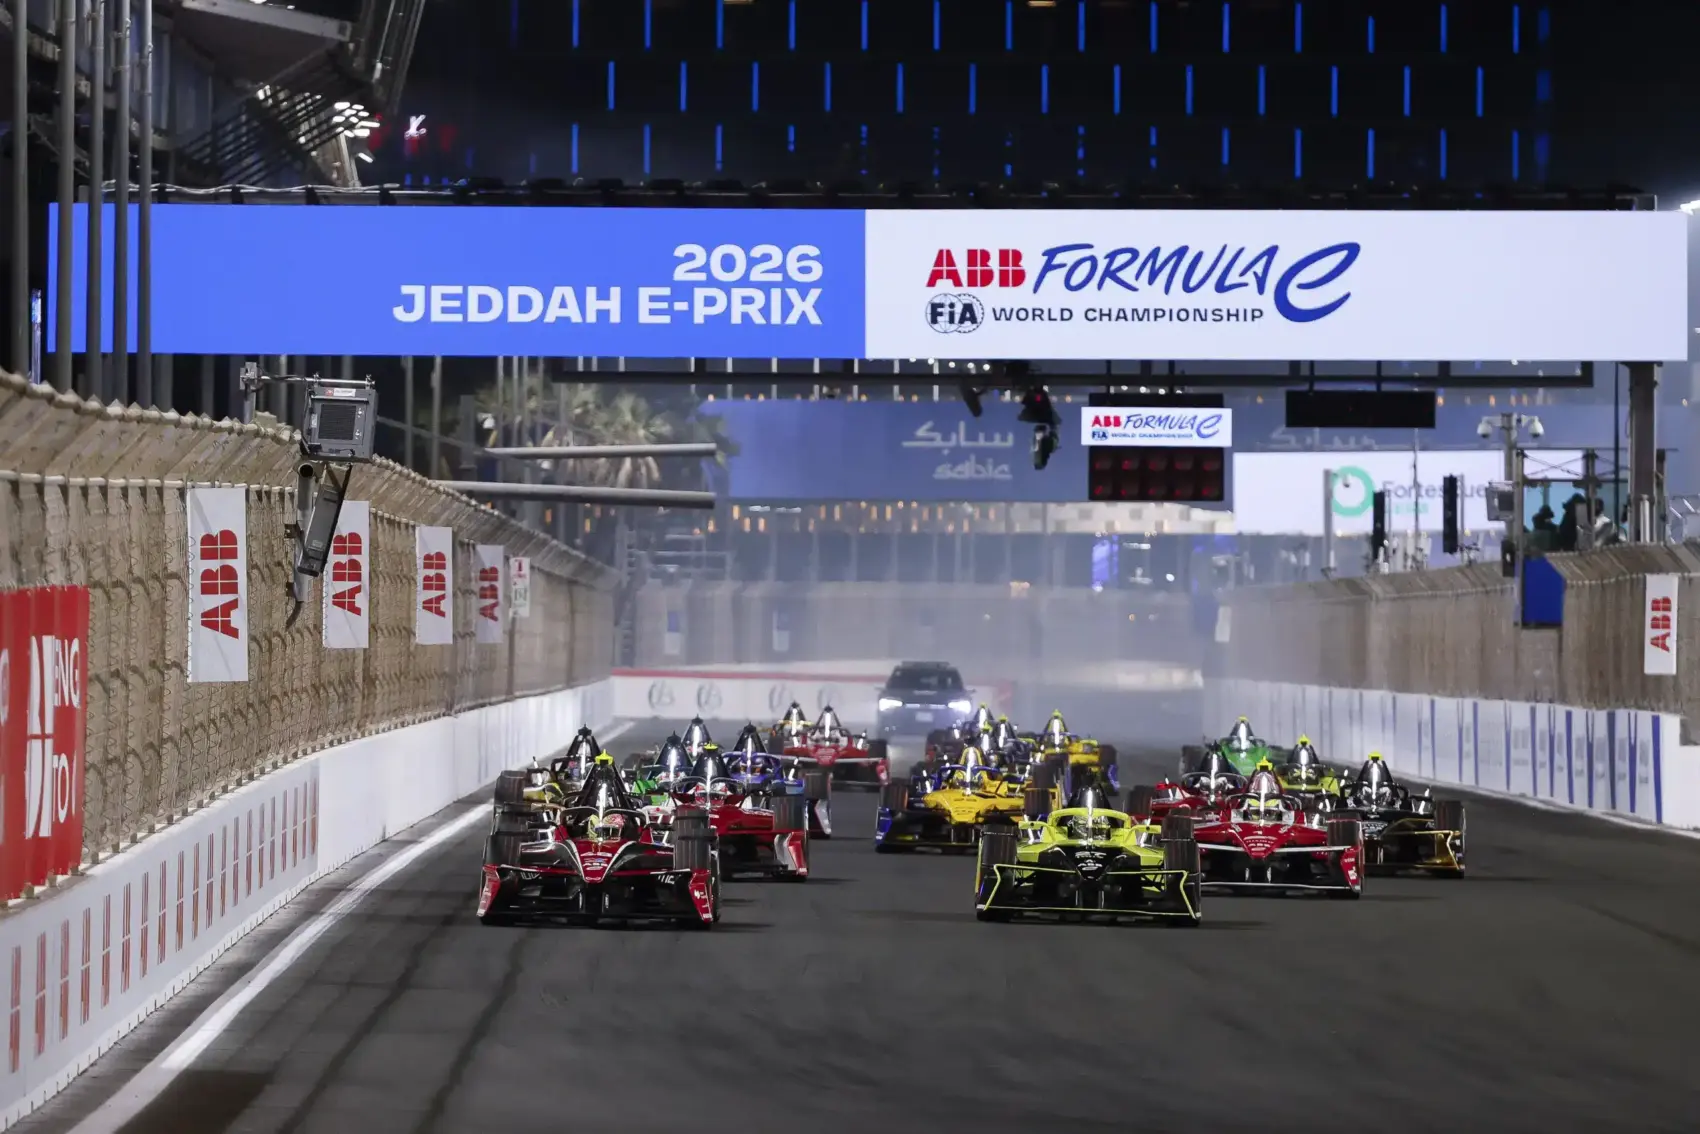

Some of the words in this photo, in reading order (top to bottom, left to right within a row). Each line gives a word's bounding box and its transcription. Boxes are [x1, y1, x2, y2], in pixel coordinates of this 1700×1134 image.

[672, 243, 824, 282] 2026
[926, 249, 1026, 287] ABB
[1032, 242, 1280, 294] FORMULA
[392, 285, 621, 323] JEDDAH
[638, 287, 824, 325] E-PRIX
[992, 307, 1074, 322] WORLD
[1084, 307, 1264, 323] CHAMPIONSHIP
[1092, 415, 1122, 428] ABB
[1123, 413, 1198, 430] FORMULA
[1382, 480, 1487, 499] Fortesue
[200, 529, 239, 640] ABB
[332, 532, 362, 617] ABB
[422, 551, 446, 618] ABB
[479, 567, 499, 621] ABB
[1650, 596, 1672, 653] ABB
